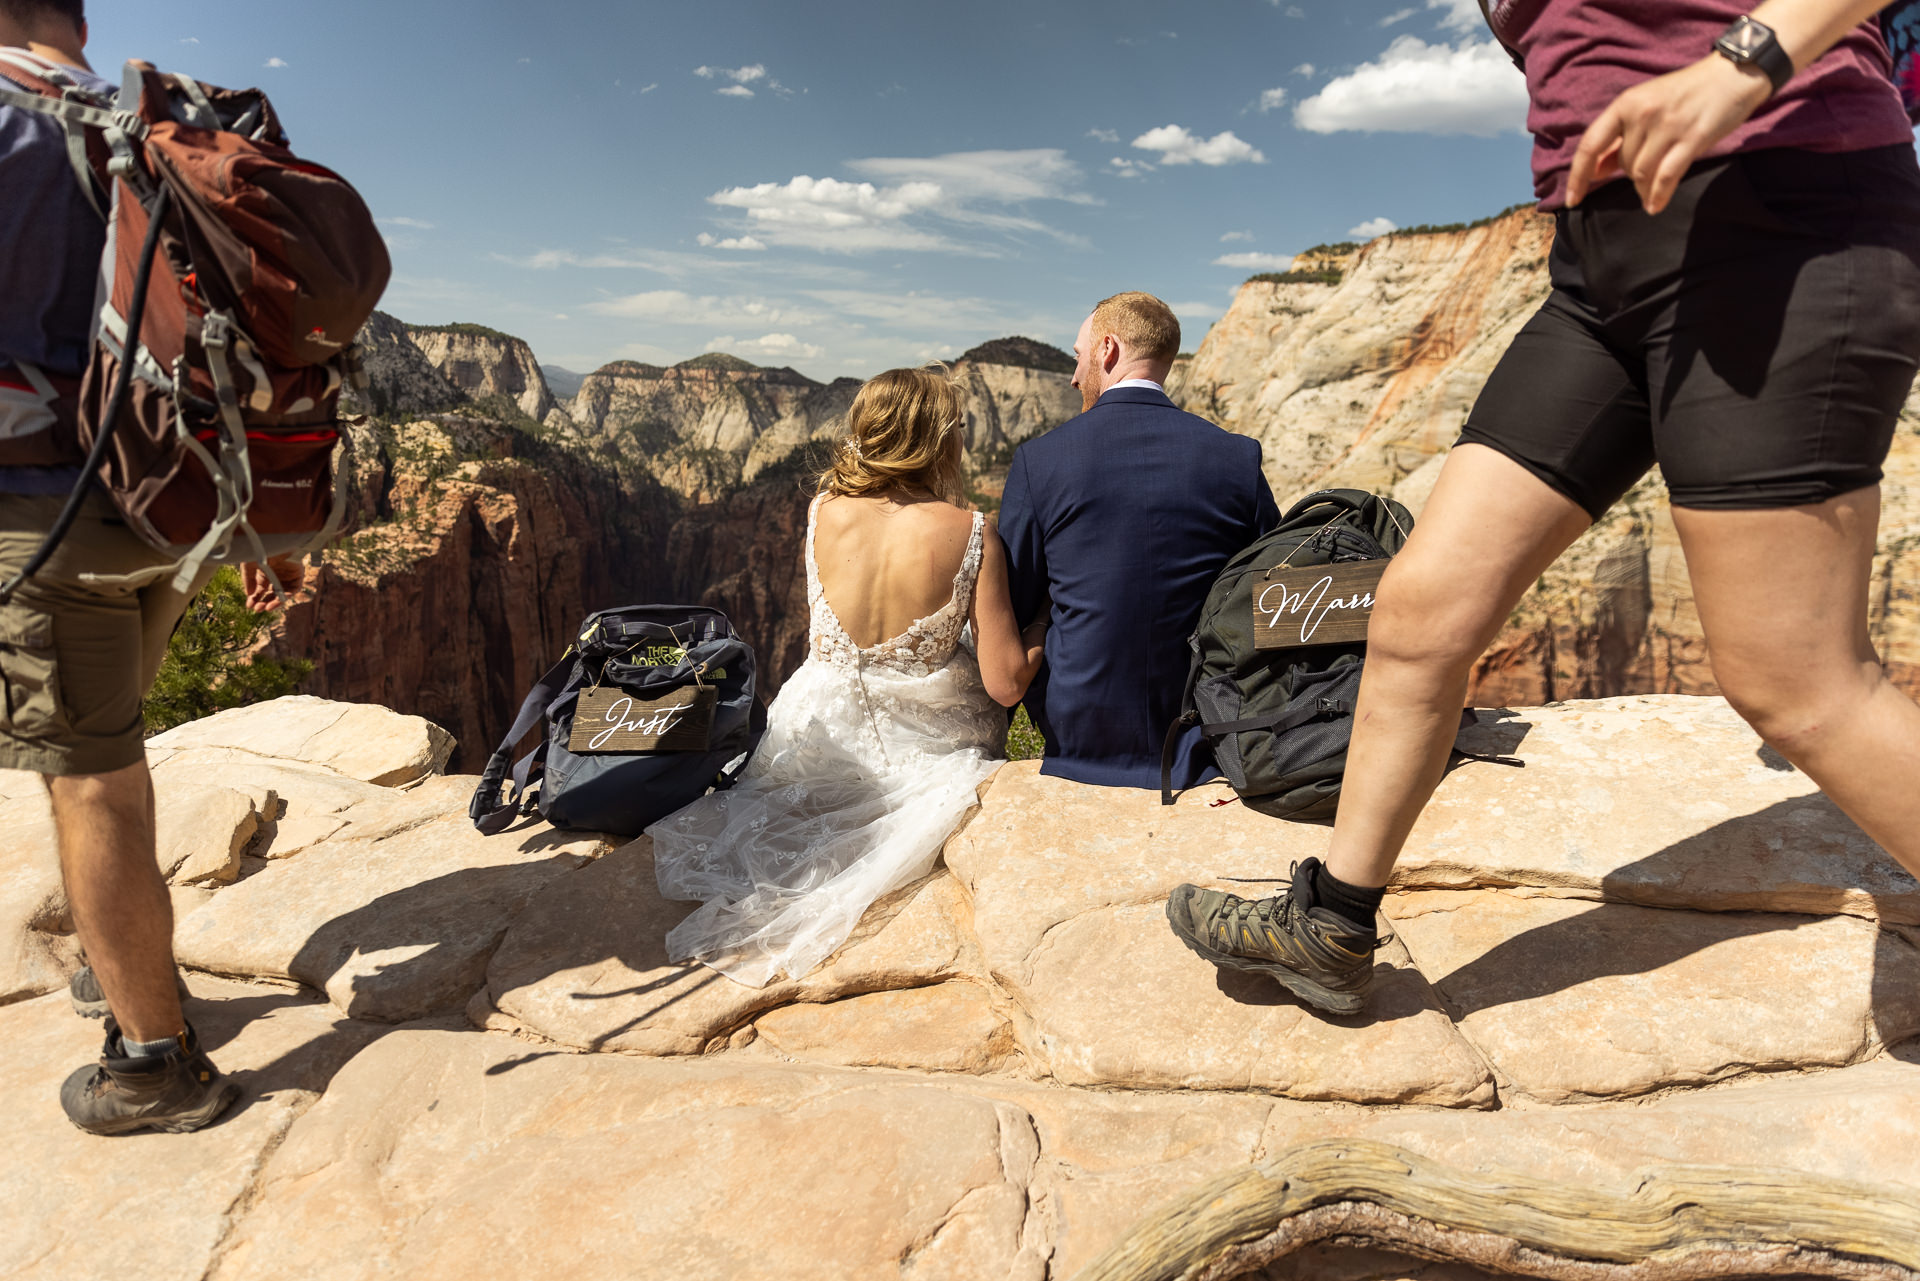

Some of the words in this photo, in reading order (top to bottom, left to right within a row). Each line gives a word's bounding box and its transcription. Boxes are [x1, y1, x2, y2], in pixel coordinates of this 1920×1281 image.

[1258, 575, 1376, 643] Marr
[647, 646, 669, 657] THE
[589, 697, 694, 749] Just
